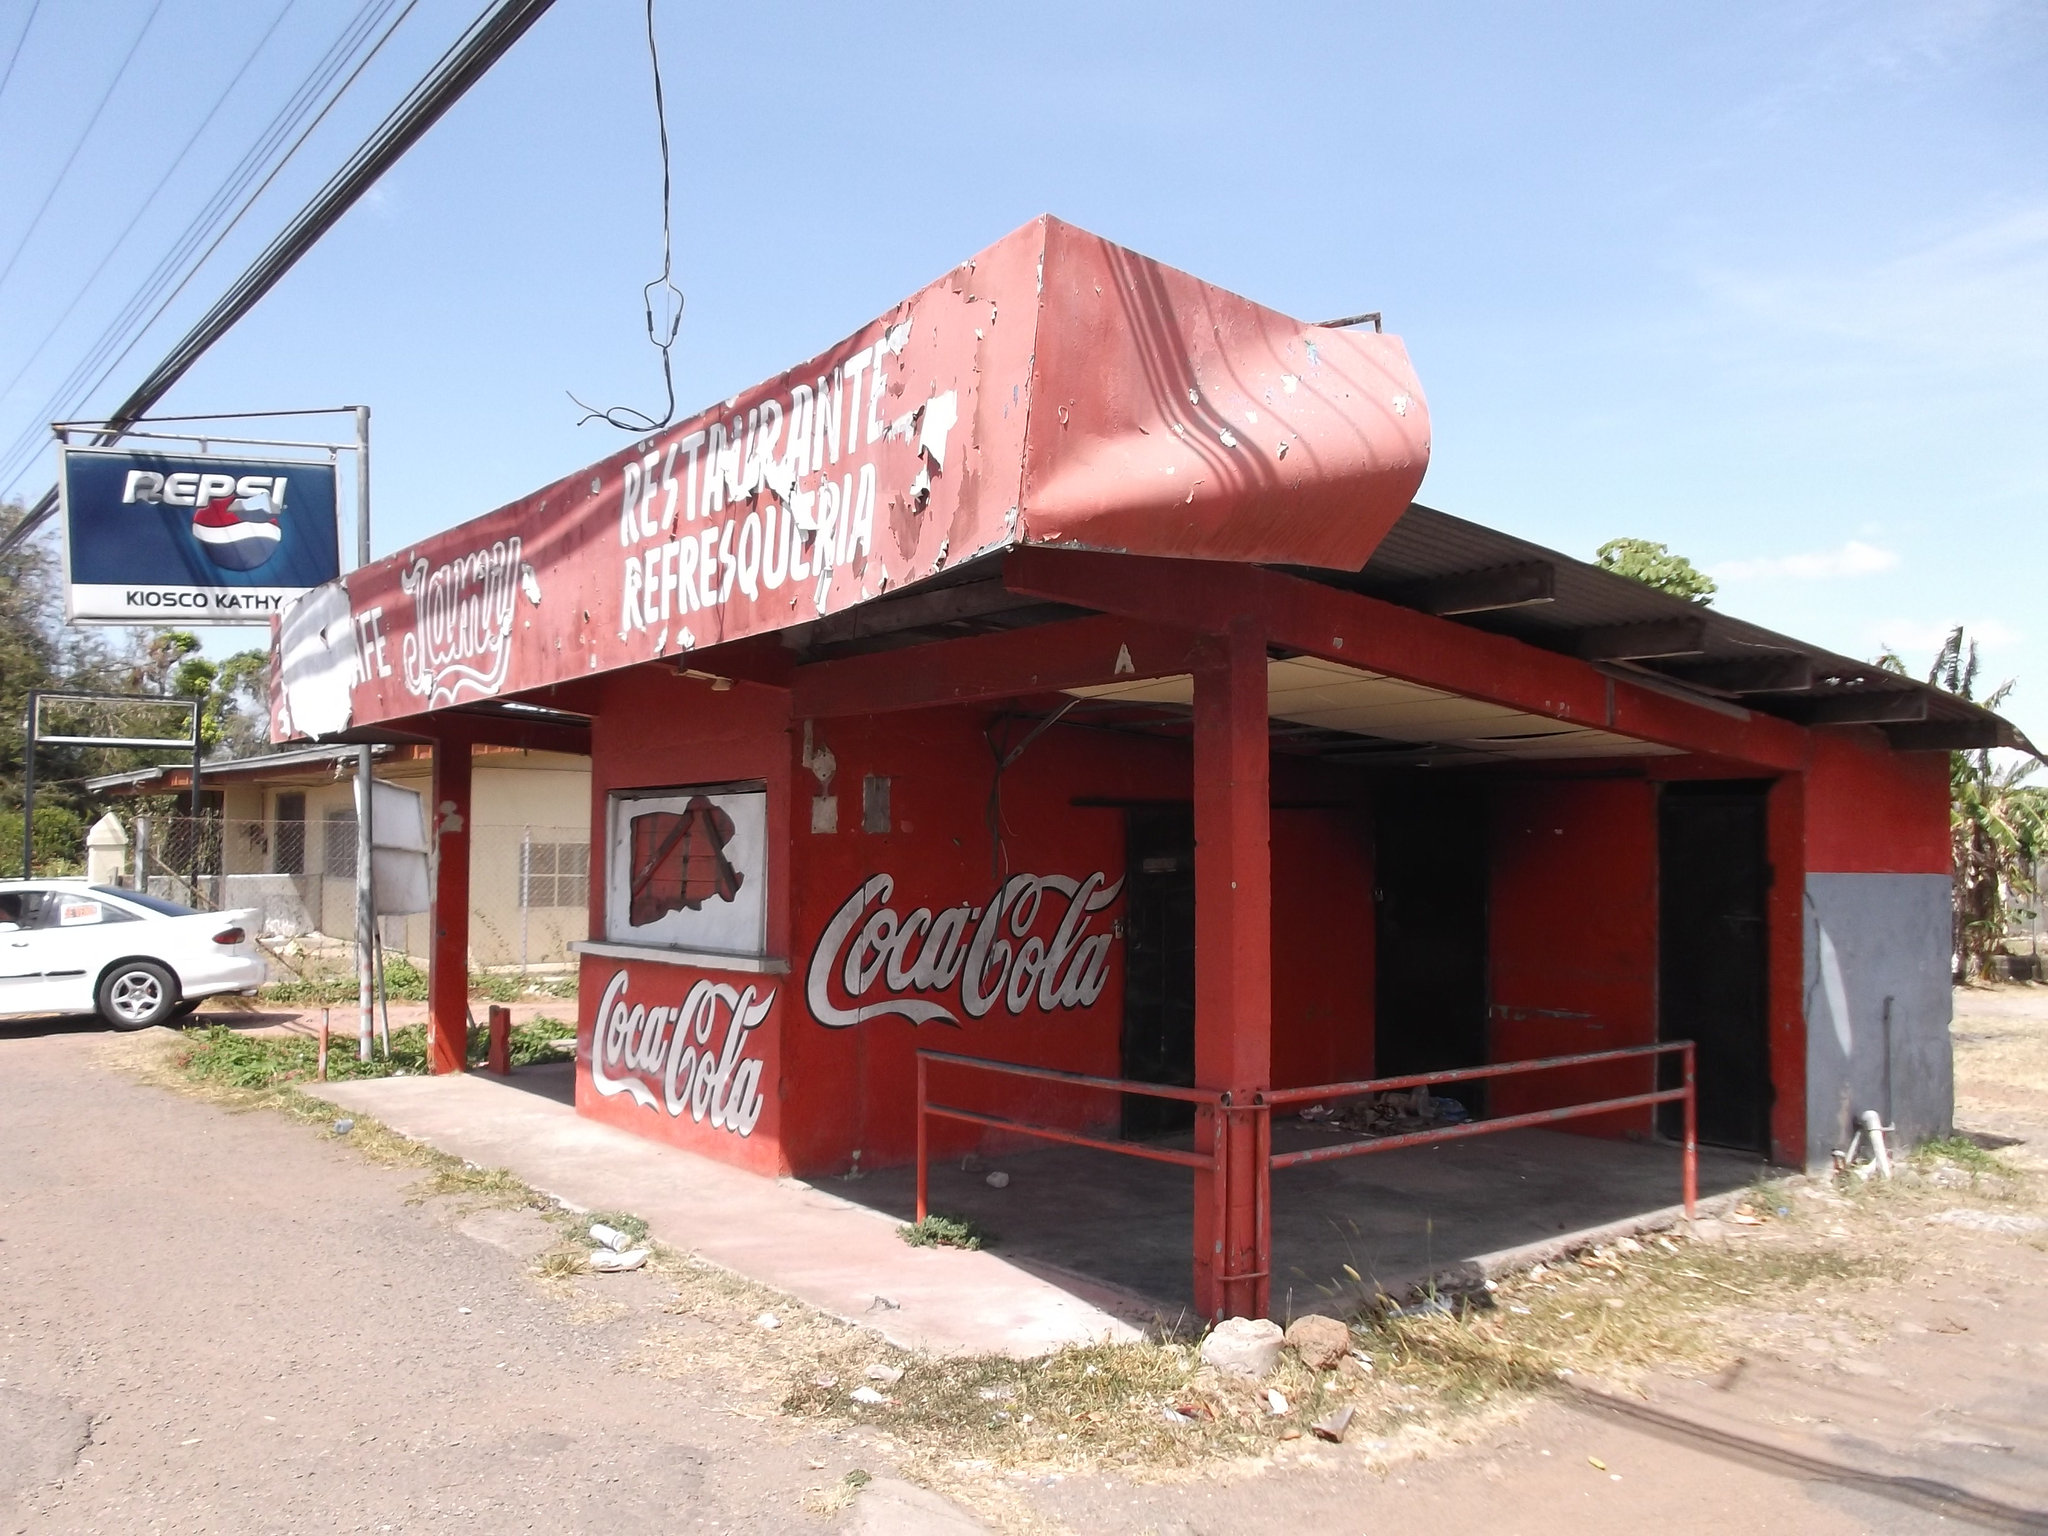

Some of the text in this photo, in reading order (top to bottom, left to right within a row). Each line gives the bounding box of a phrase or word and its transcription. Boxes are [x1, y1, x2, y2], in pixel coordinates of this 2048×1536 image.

[122, 469, 288, 512] PEPSI
[621, 335, 905, 547] RESTAURANTE
[126, 591, 283, 610] KIOSCO KATHY
[621, 462, 877, 633] REFRESQUERIA
[805, 872, 1125, 1028] Coca-Cola
[591, 969, 778, 1138] Coca-Cola
